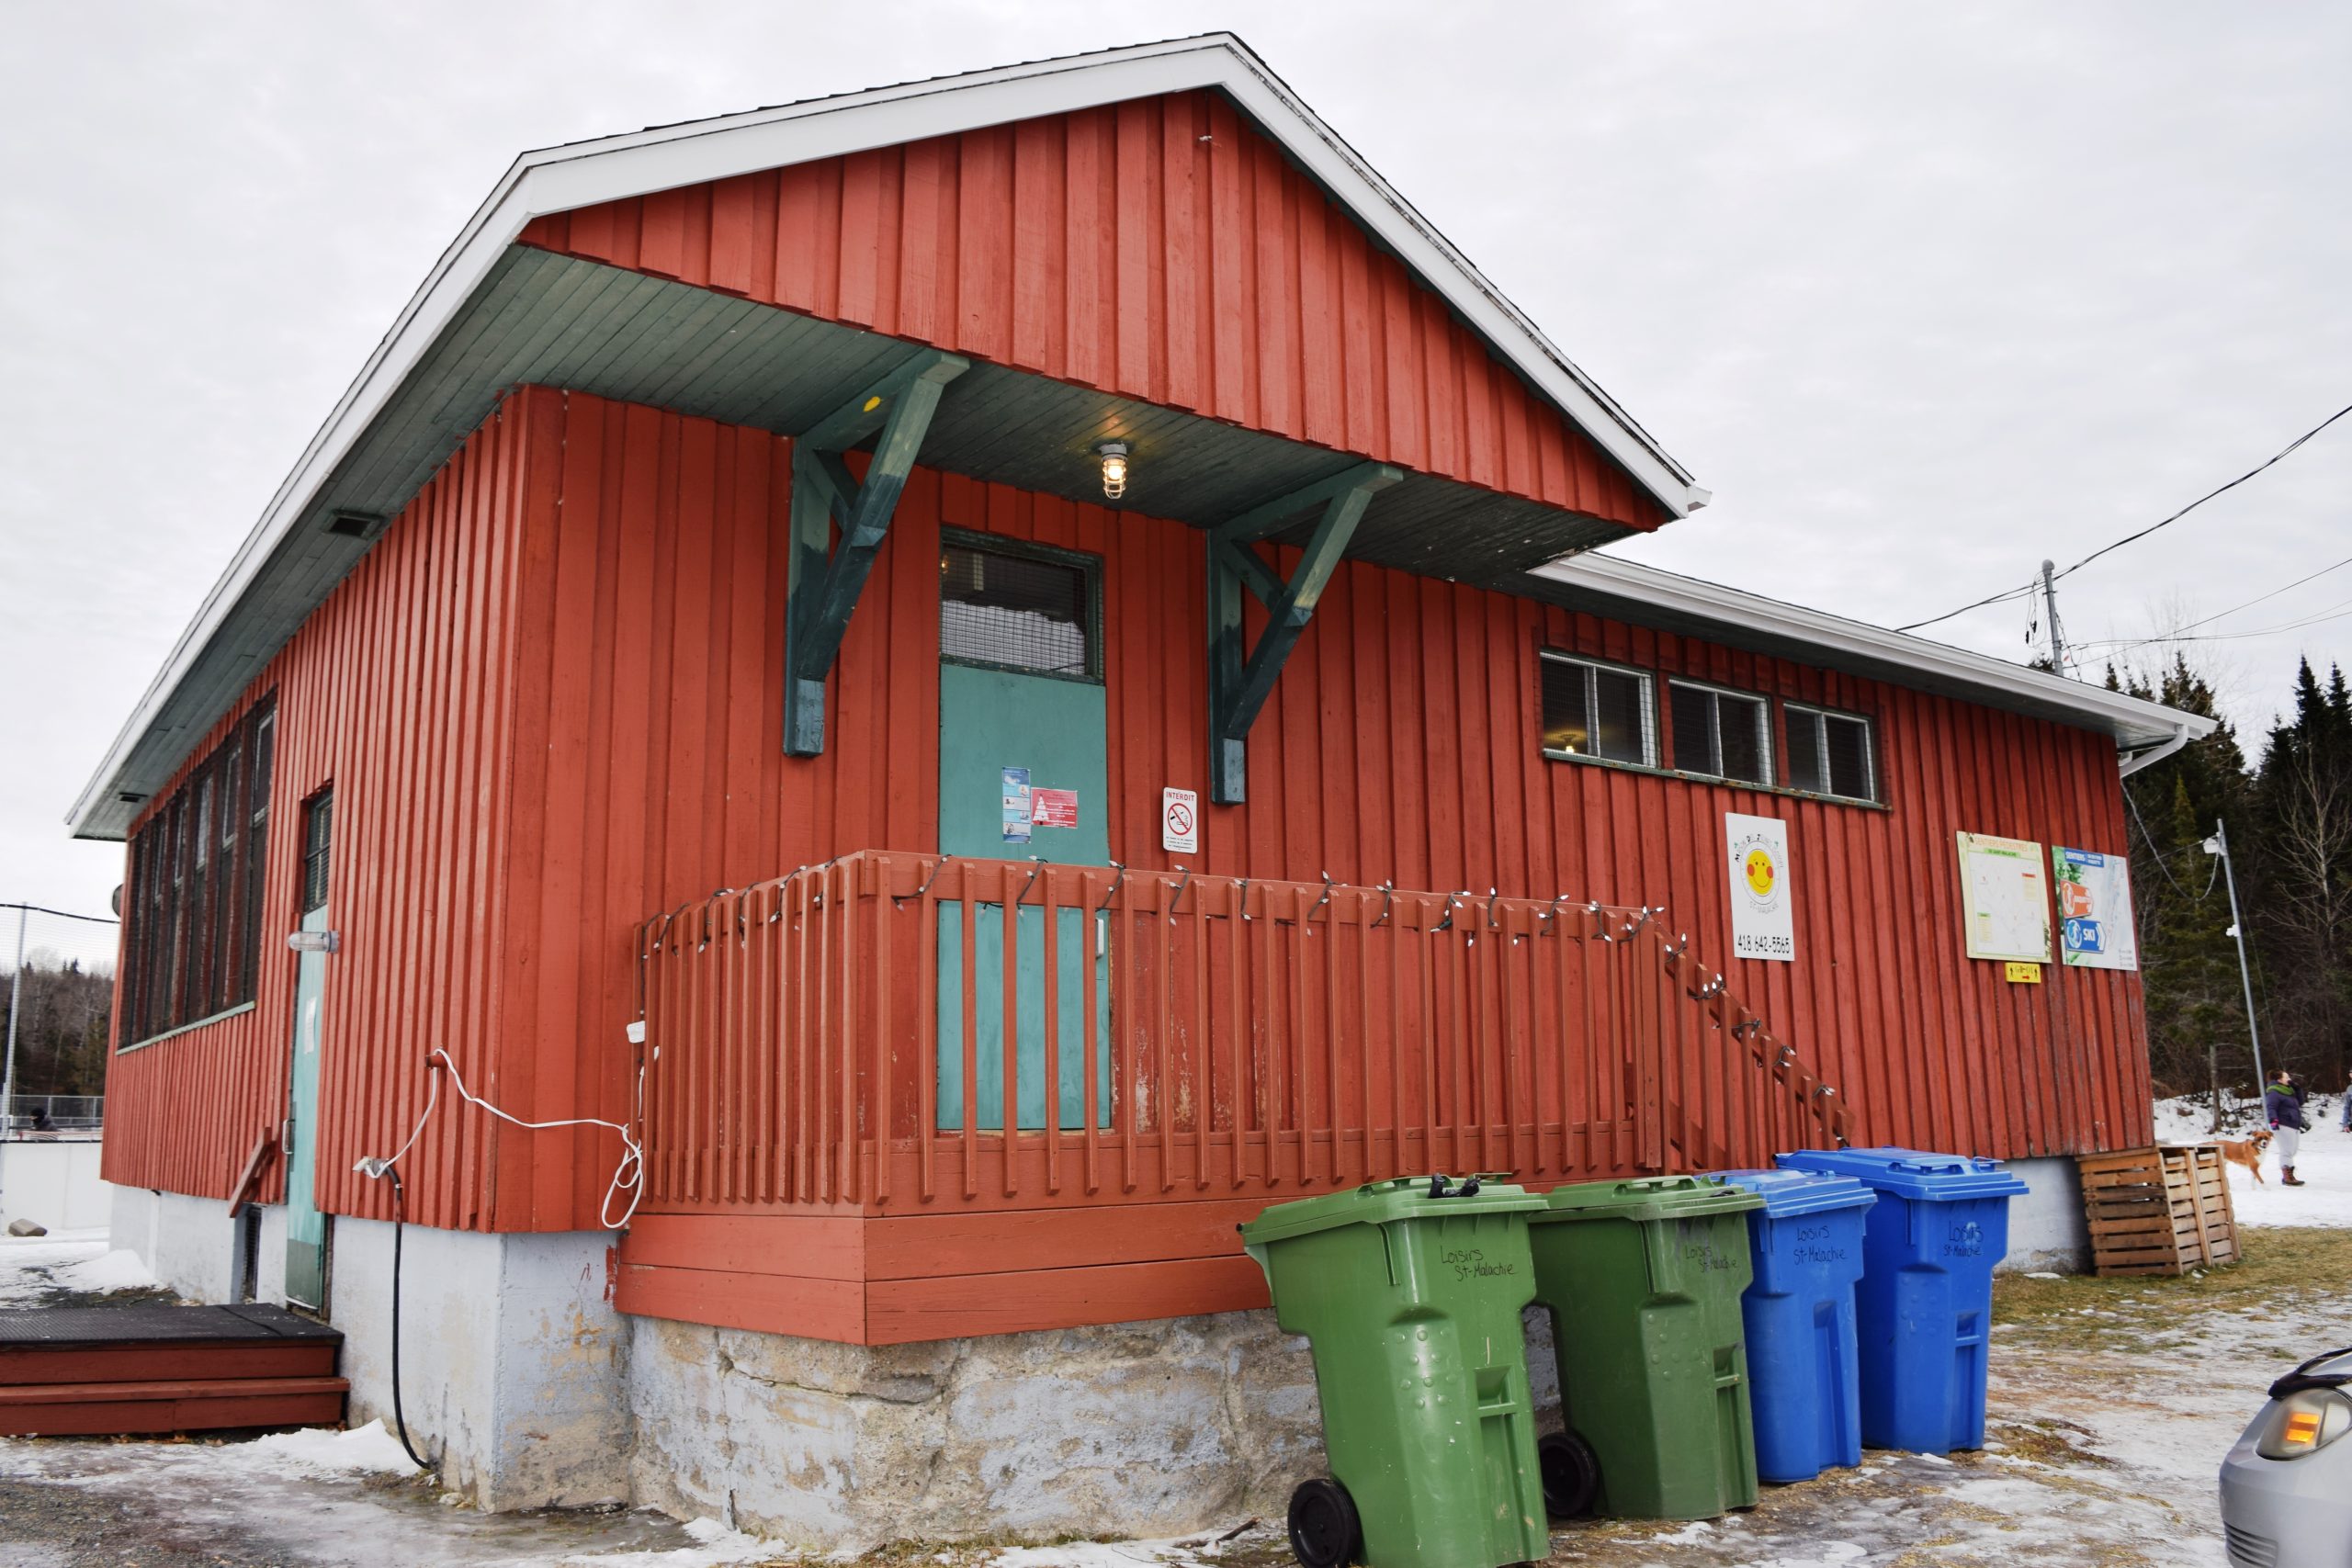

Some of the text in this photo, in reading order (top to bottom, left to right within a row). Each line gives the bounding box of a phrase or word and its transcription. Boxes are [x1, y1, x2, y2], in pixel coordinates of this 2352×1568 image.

[1166, 792, 1195, 801] INTERDIT
[1737, 934, 1791, 953] 418 642-5565
[2083, 928, 2096, 942] SKI
[1797, 1225, 1830, 1241] Loisirs
[1440, 1245, 1484, 1264] Loisirs
[1793, 1245, 1848, 1266] St-Malachie
[1454, 1261, 1516, 1281] St-Malachie
